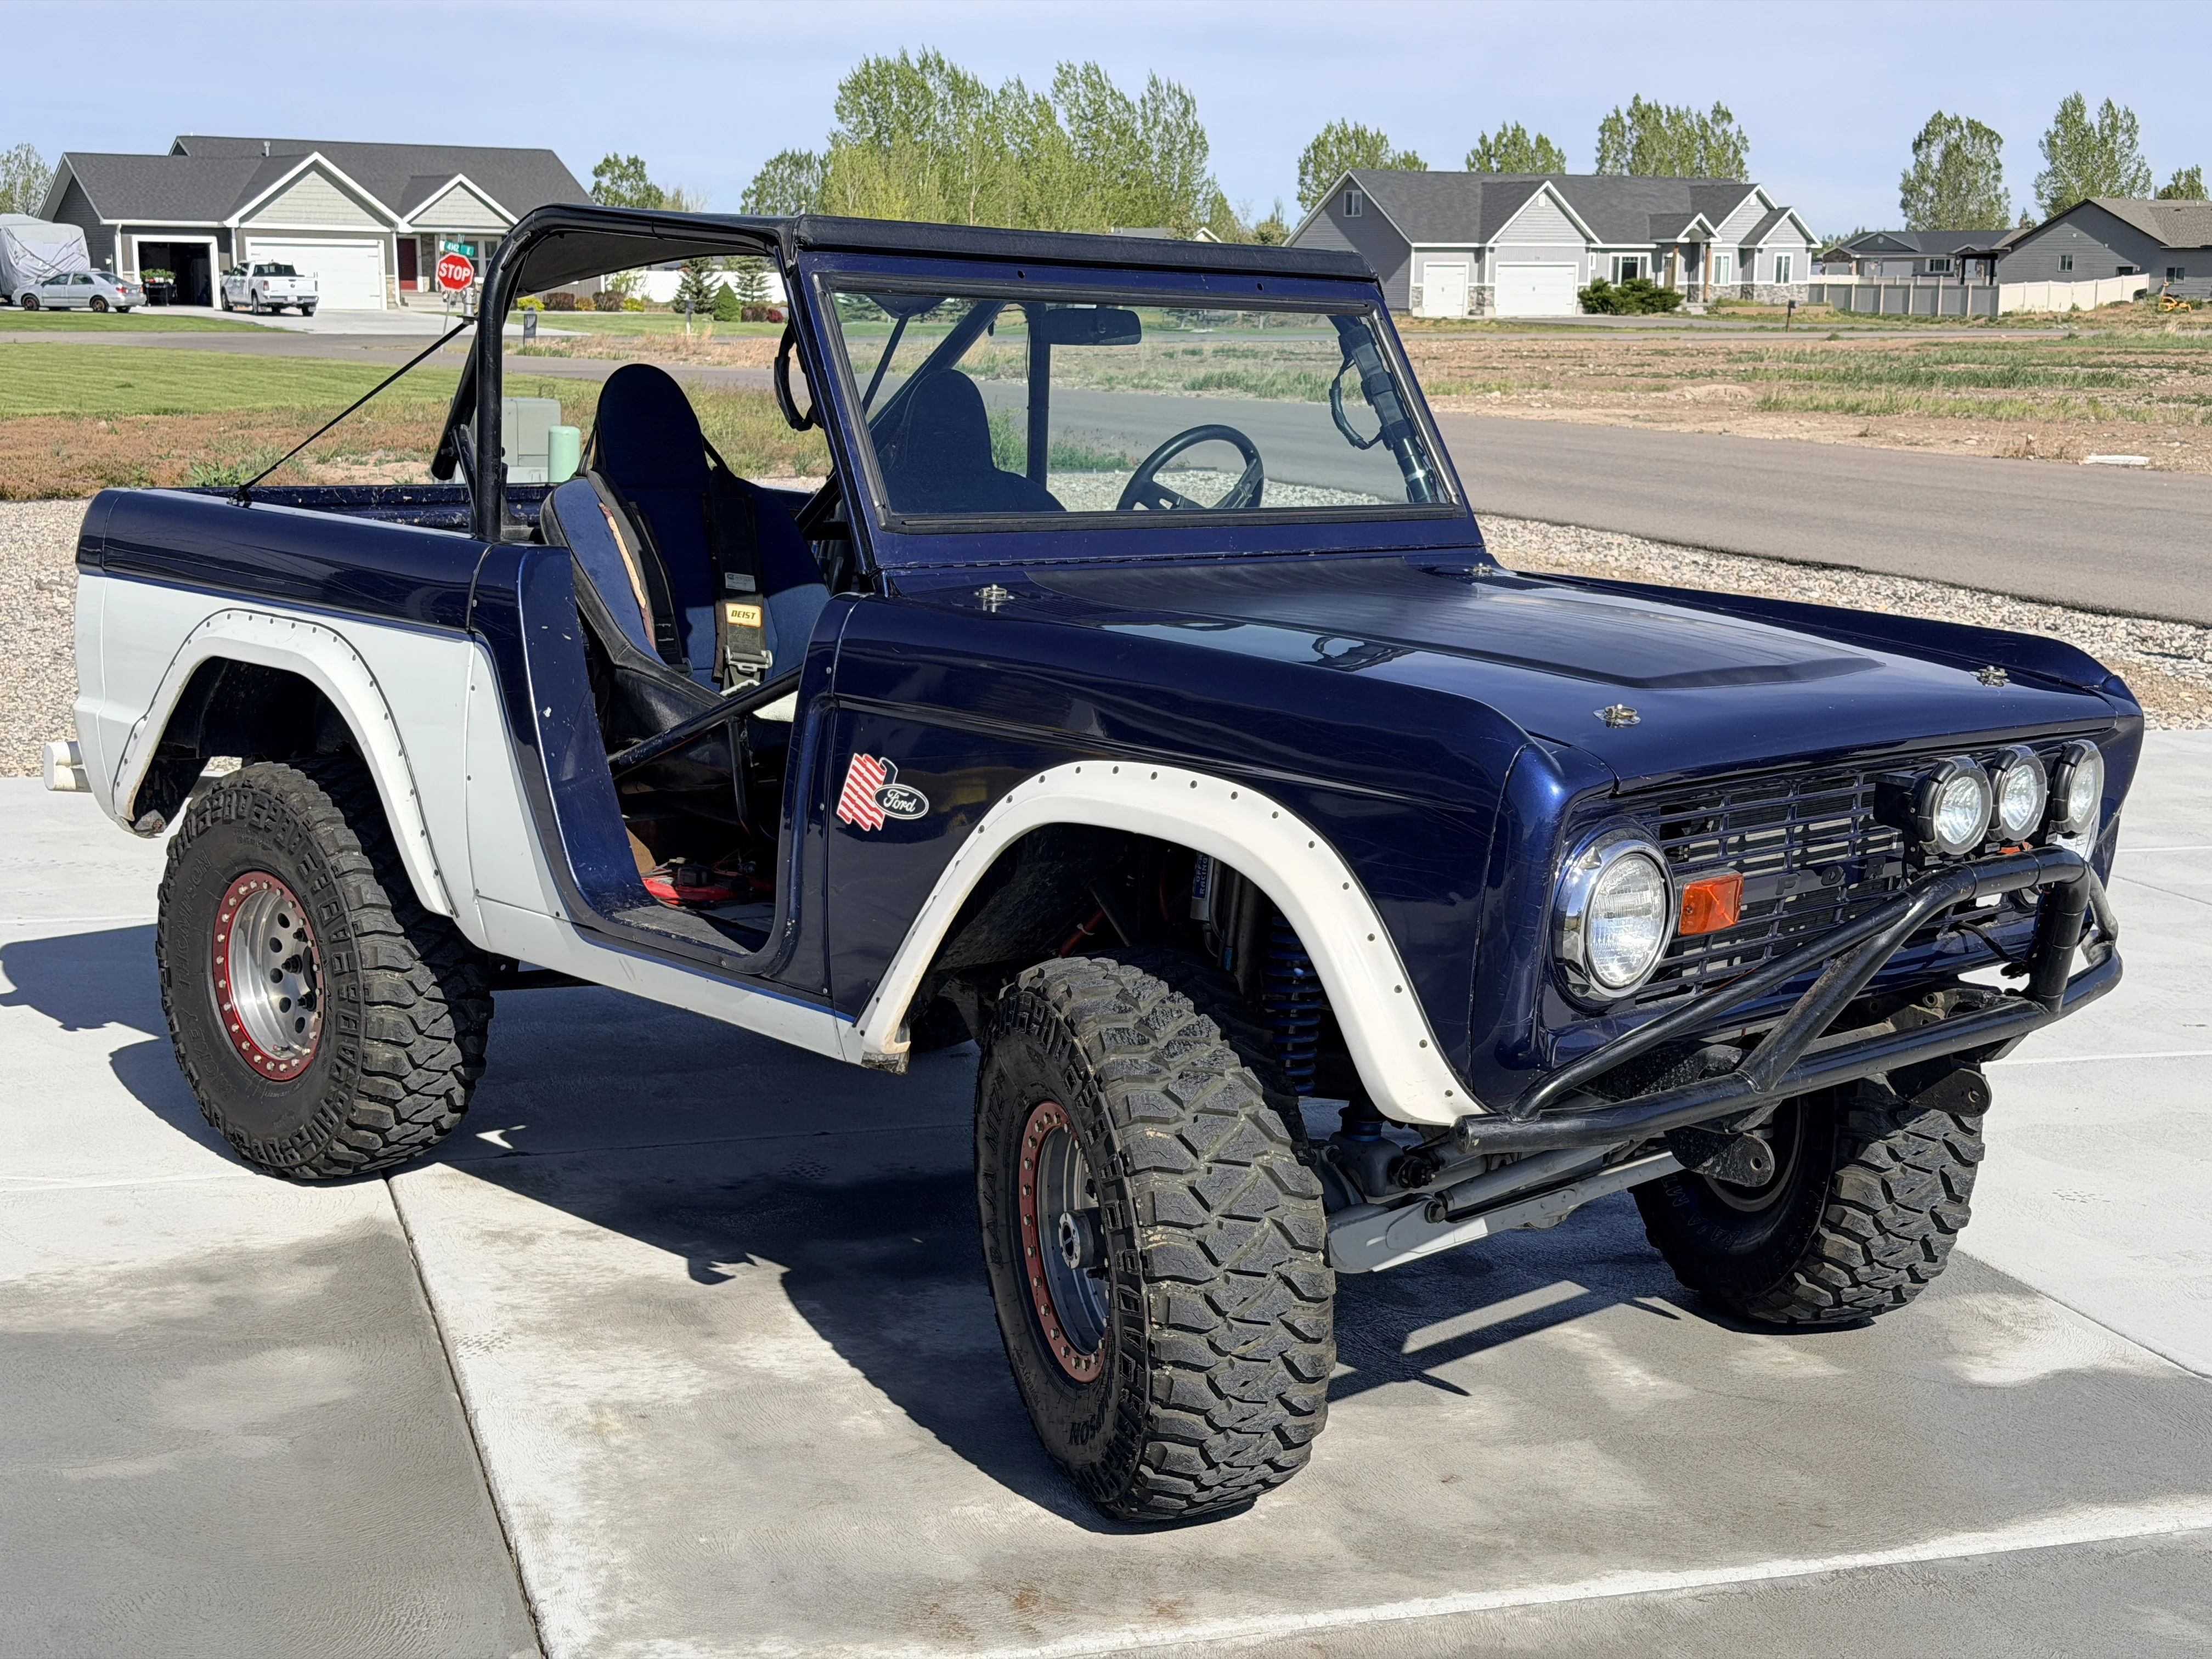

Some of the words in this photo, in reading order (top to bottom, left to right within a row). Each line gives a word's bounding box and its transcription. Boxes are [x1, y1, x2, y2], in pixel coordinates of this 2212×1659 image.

[439, 263, 471, 281] STOP
[731, 610, 757, 619] DEIST
[883, 789, 917, 812] Ford
[1199, 857, 1207, 895] RACING
[1775, 856, 1886, 896] FOR
[173, 849, 212, 990] THOMPSON
[983, 1169, 1003, 1268] BAJA
[1688, 1210, 1741, 1245] BAJA
